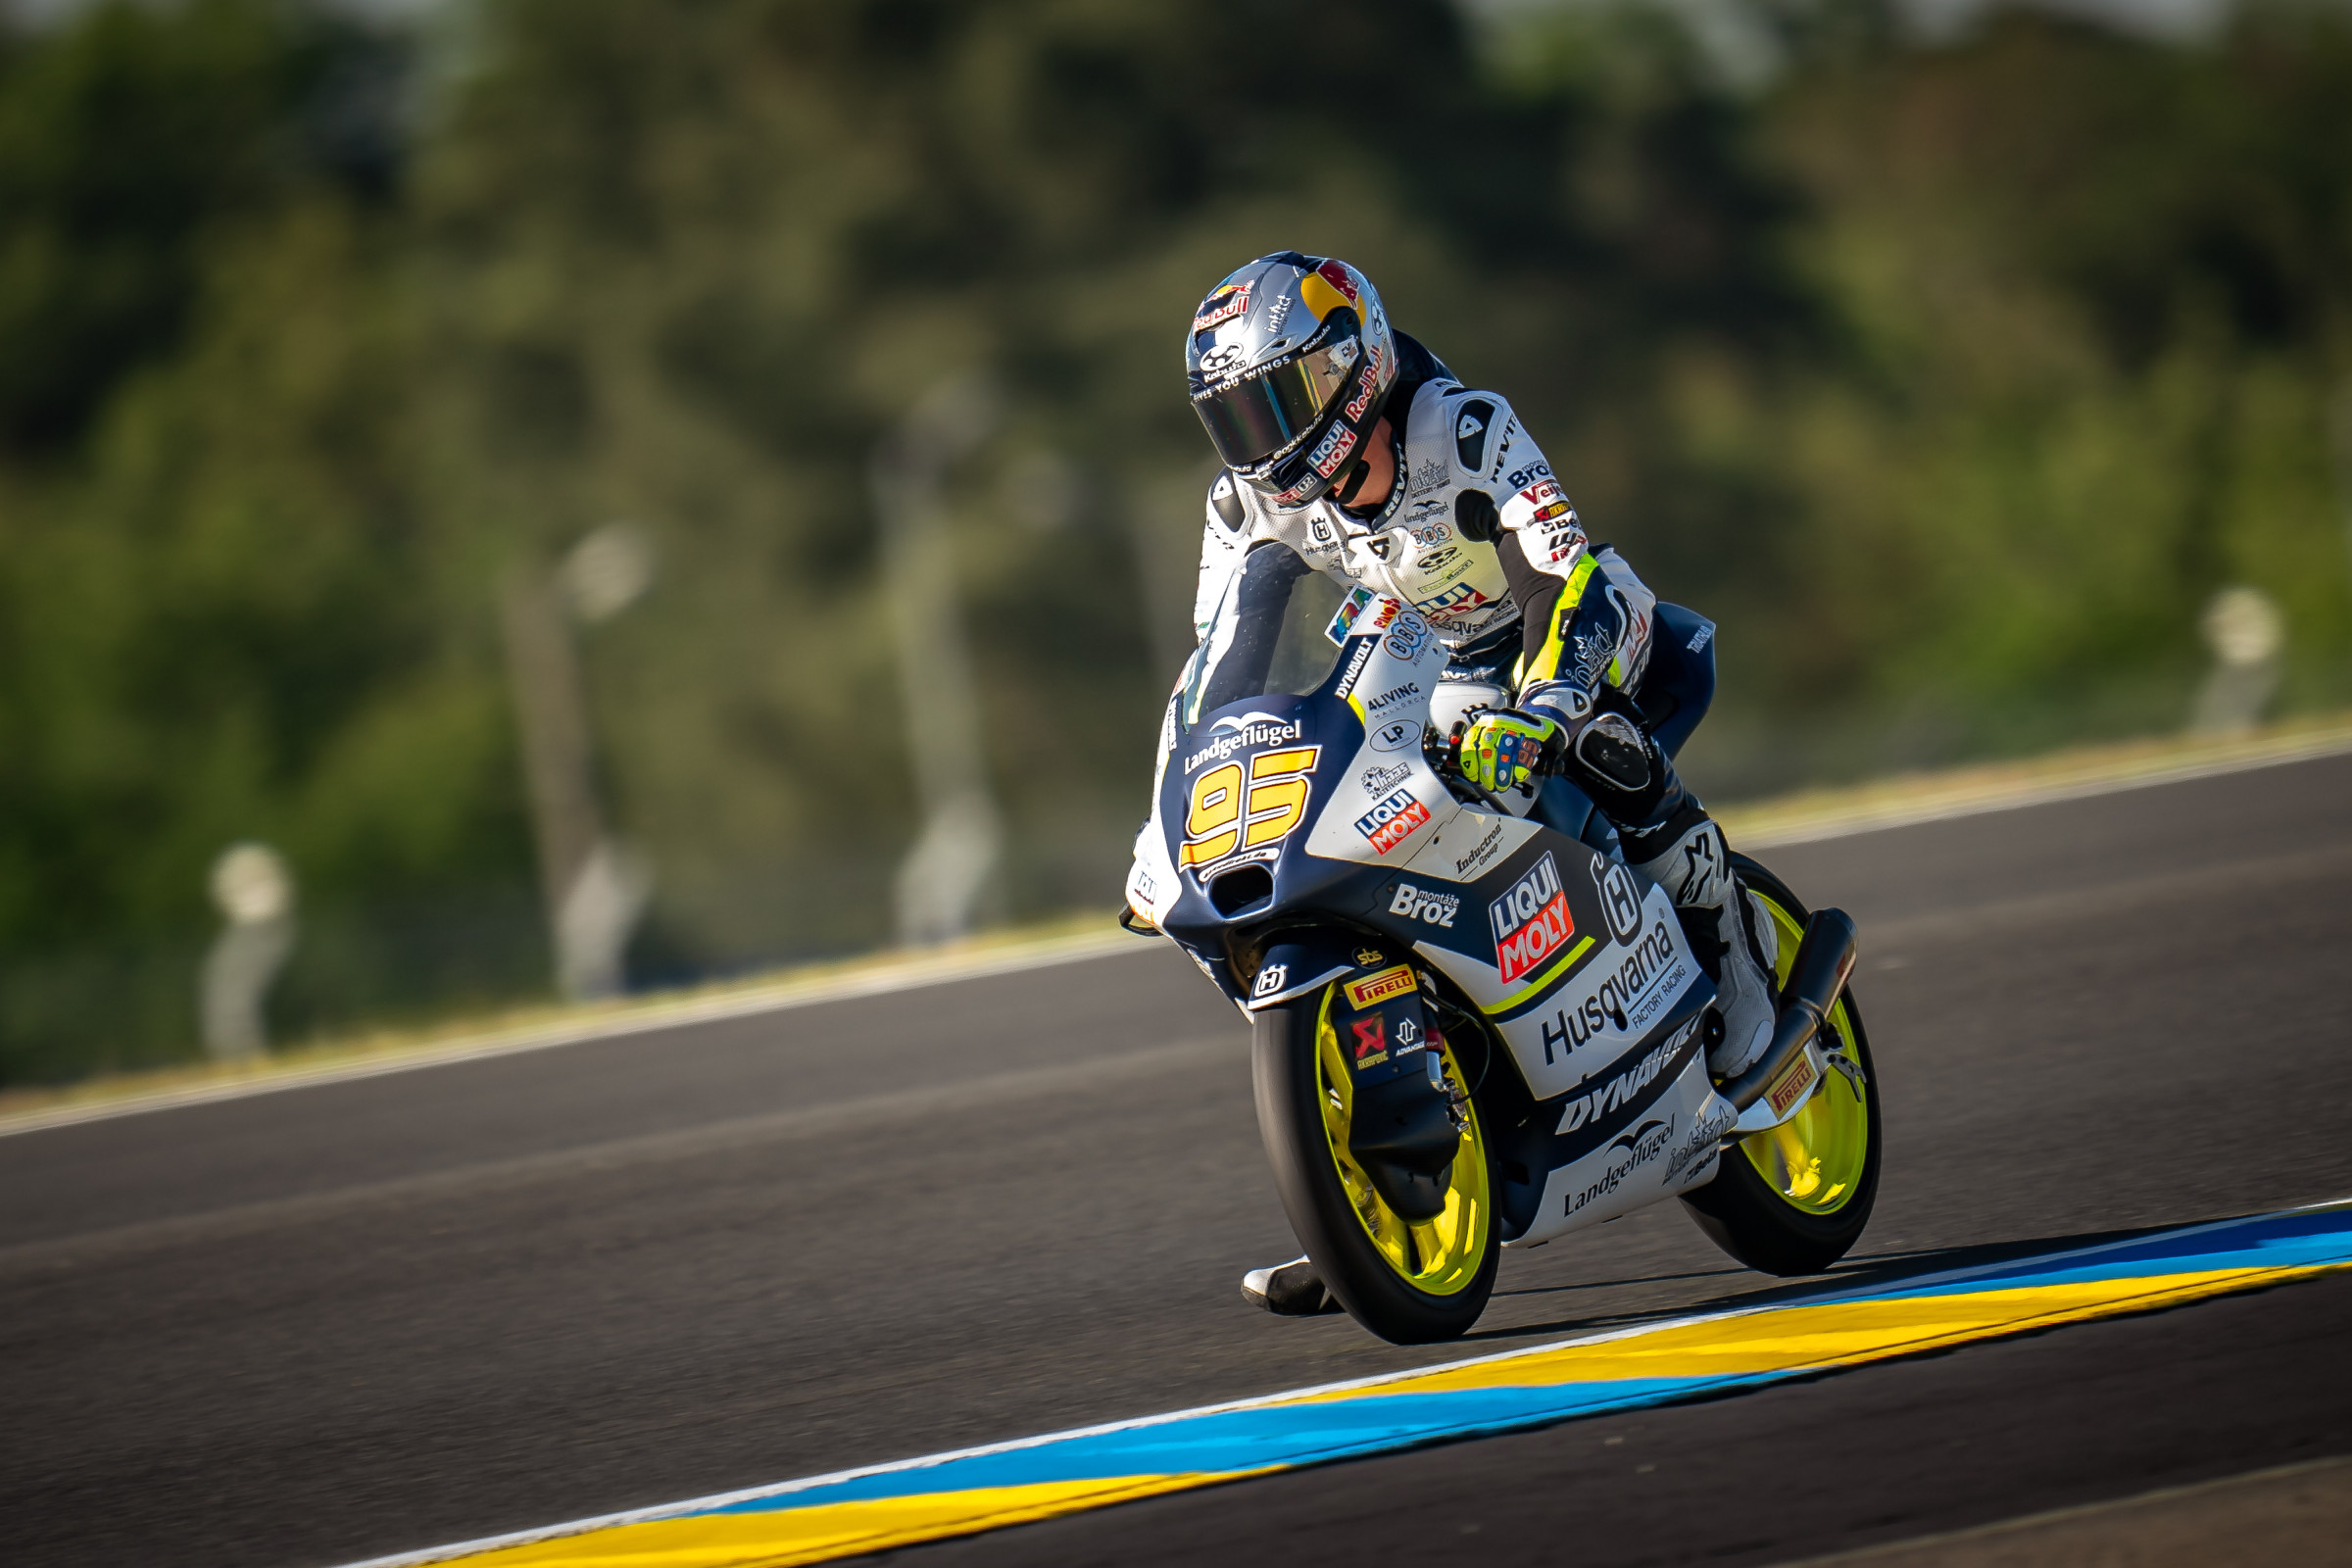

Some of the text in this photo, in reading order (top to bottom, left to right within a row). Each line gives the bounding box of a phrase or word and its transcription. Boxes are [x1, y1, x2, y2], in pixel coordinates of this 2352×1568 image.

[1301, 324, 1331, 353] Kabuto
[1202, 360, 1247, 383] Kabuto
[1214, 376, 1240, 393] YOU
[1244, 354, 1292, 380] WINGS
[1345, 376, 1373, 423] Red
[1361, 344, 1384, 386] Bull
[1309, 423, 1344, 466] LIQUI
[1319, 431, 1353, 475] MOLY
[1506, 465, 1554, 490] Bro
[1413, 525, 1446, 545] BBS
[1389, 615, 1422, 655] BBS
[1335, 636, 1374, 700] DYNAVOLT
[1374, 695, 1426, 719] MALLORCA
[1184, 719, 1301, 775] Landgeflügel
[1382, 725, 1404, 744] LP
[1178, 744, 1323, 874] 95
[1357, 791, 1415, 836] LIQUI
[1373, 804, 1429, 853] MOLY
[1455, 816, 1502, 874] Inductron
[1478, 842, 1498, 867] Group
[1389, 883, 1457, 928] Brož
[1417, 888, 1460, 907] montáže
[1494, 858, 1559, 938] LIQUI
[1356, 948, 1384, 965] sbs
[1500, 896, 1568, 979] MOLY
[1353, 969, 1413, 1004] PIRELLI
[1541, 919, 1675, 1066] Husqvarna
[1632, 964, 1687, 1029] FACTORY RACING
[1771, 1060, 1812, 1111] PIRELLI
[1563, 1111, 1677, 1218] Landgeflügel
